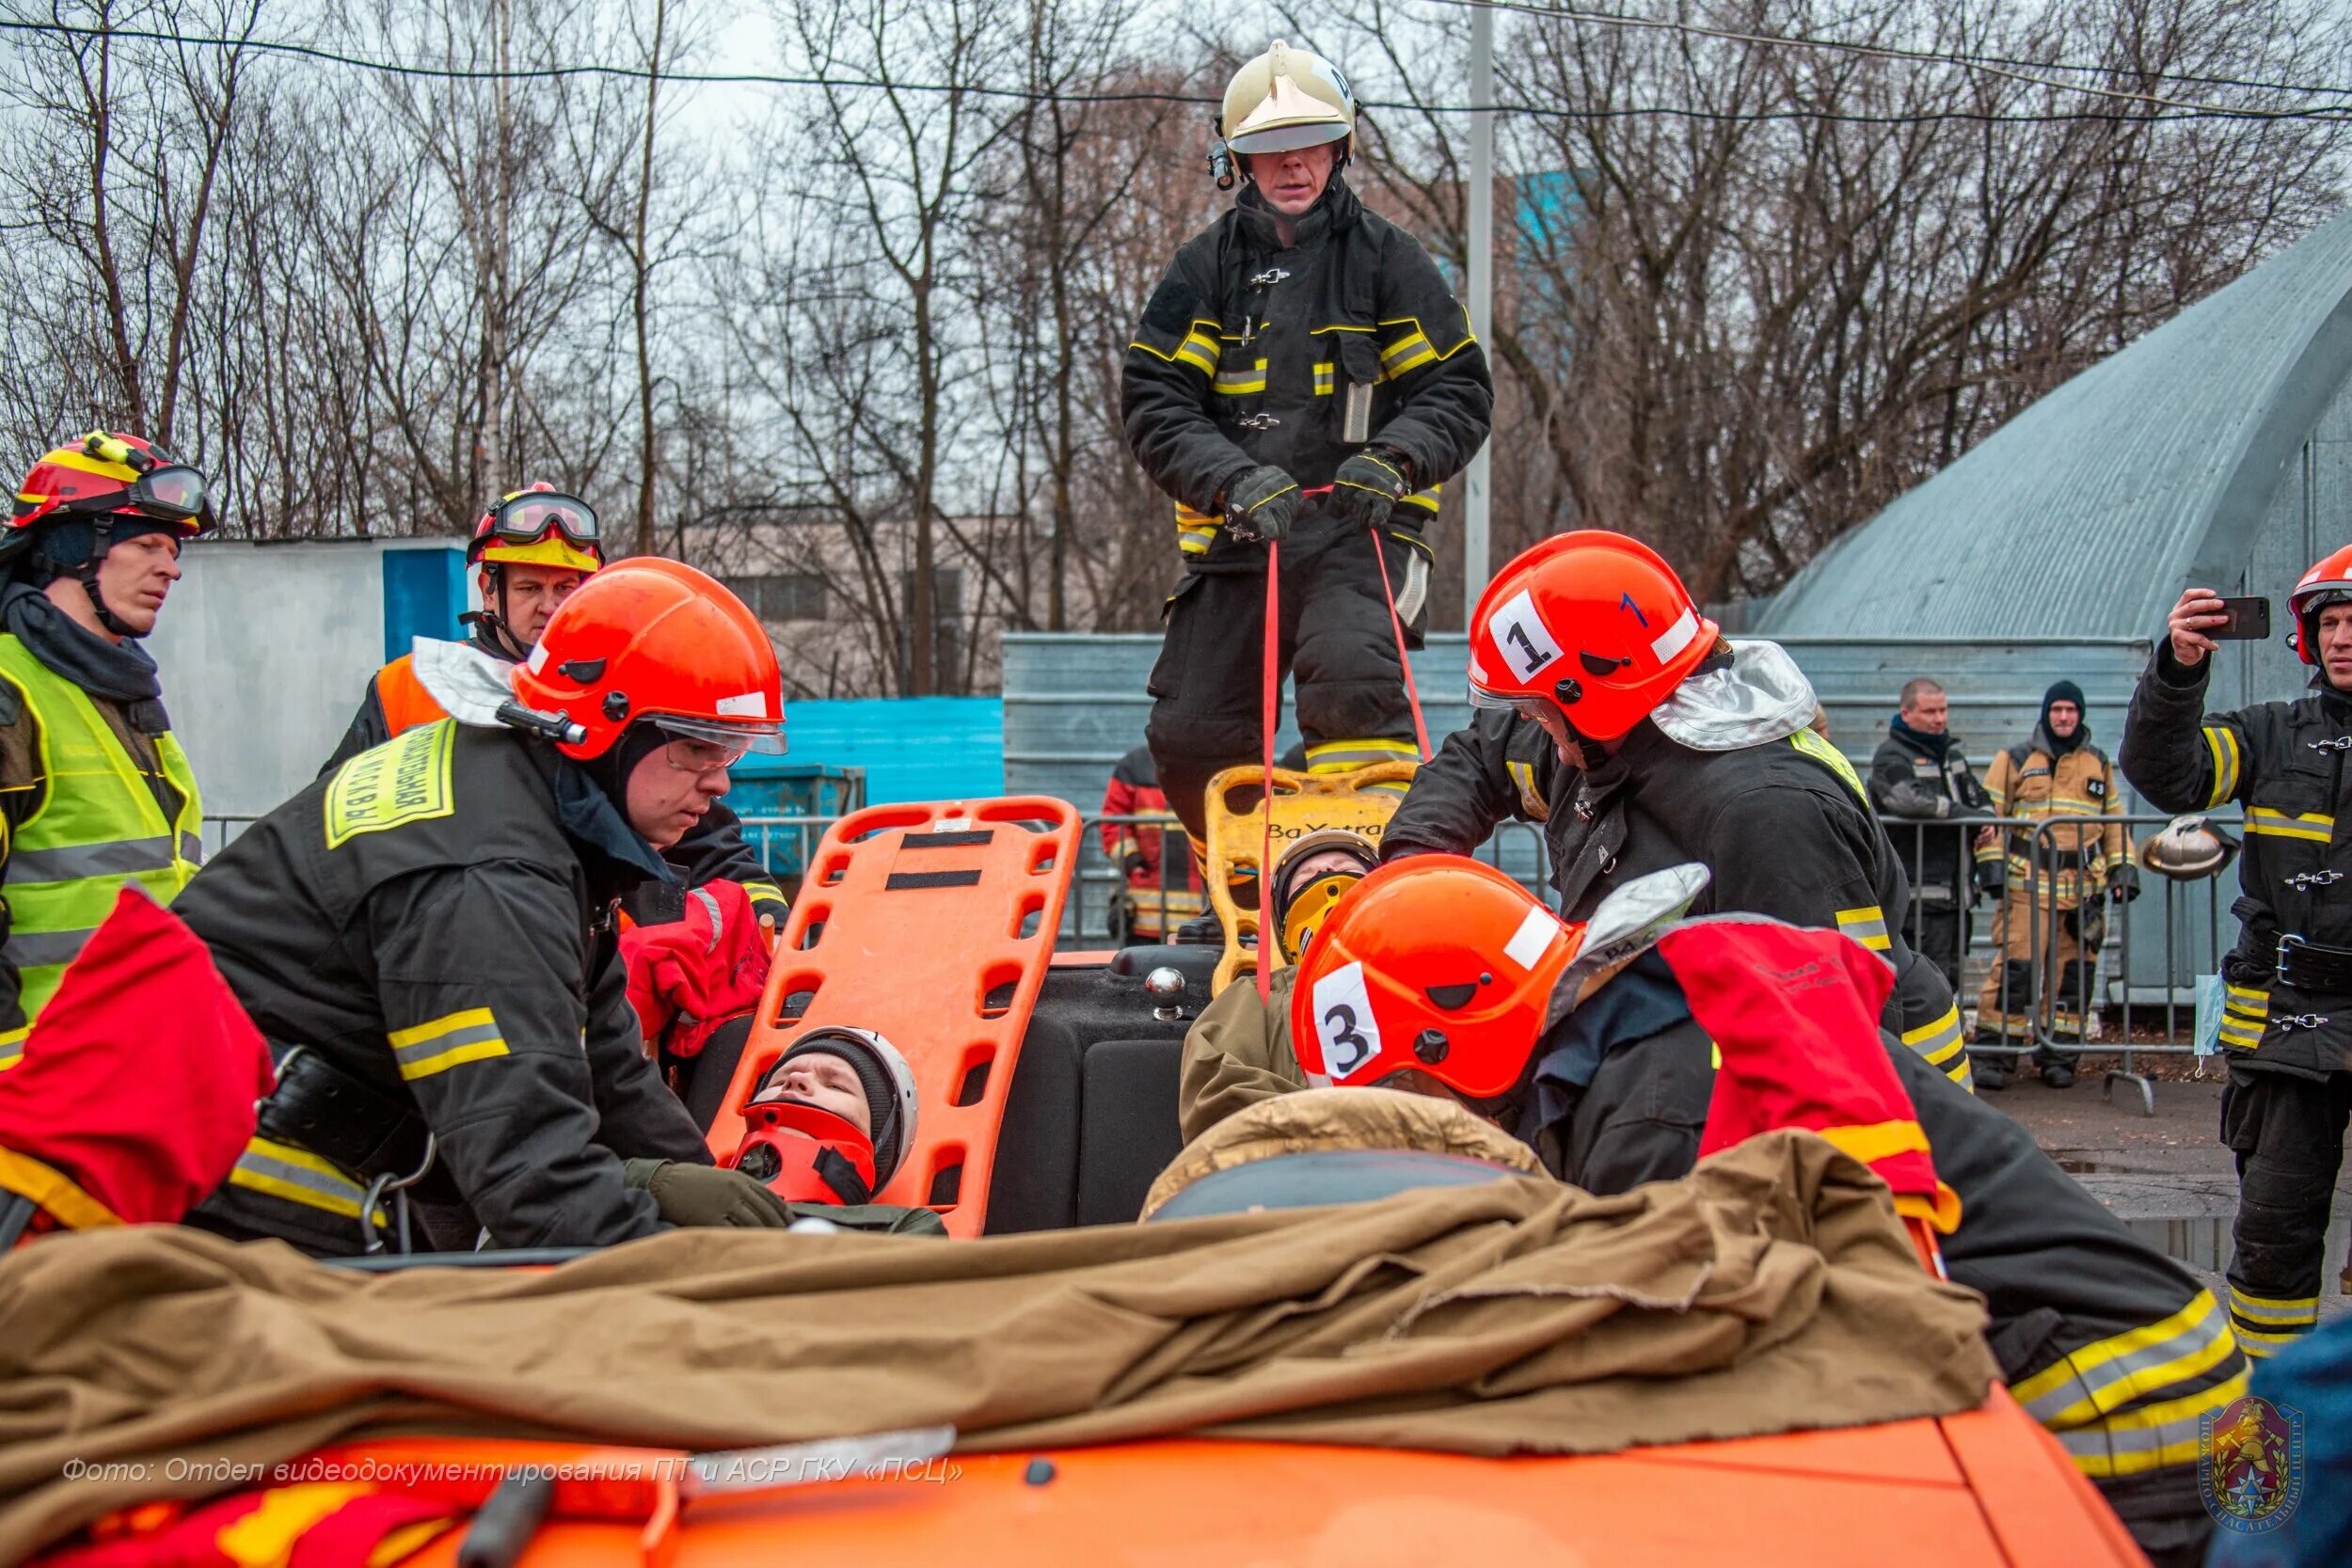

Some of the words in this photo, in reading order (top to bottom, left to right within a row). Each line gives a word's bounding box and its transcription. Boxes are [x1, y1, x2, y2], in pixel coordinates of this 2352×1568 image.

[1507, 621, 1551, 674] 1
[2088, 781, 2106, 796] 43
[1325, 1004, 1369, 1072] 3
